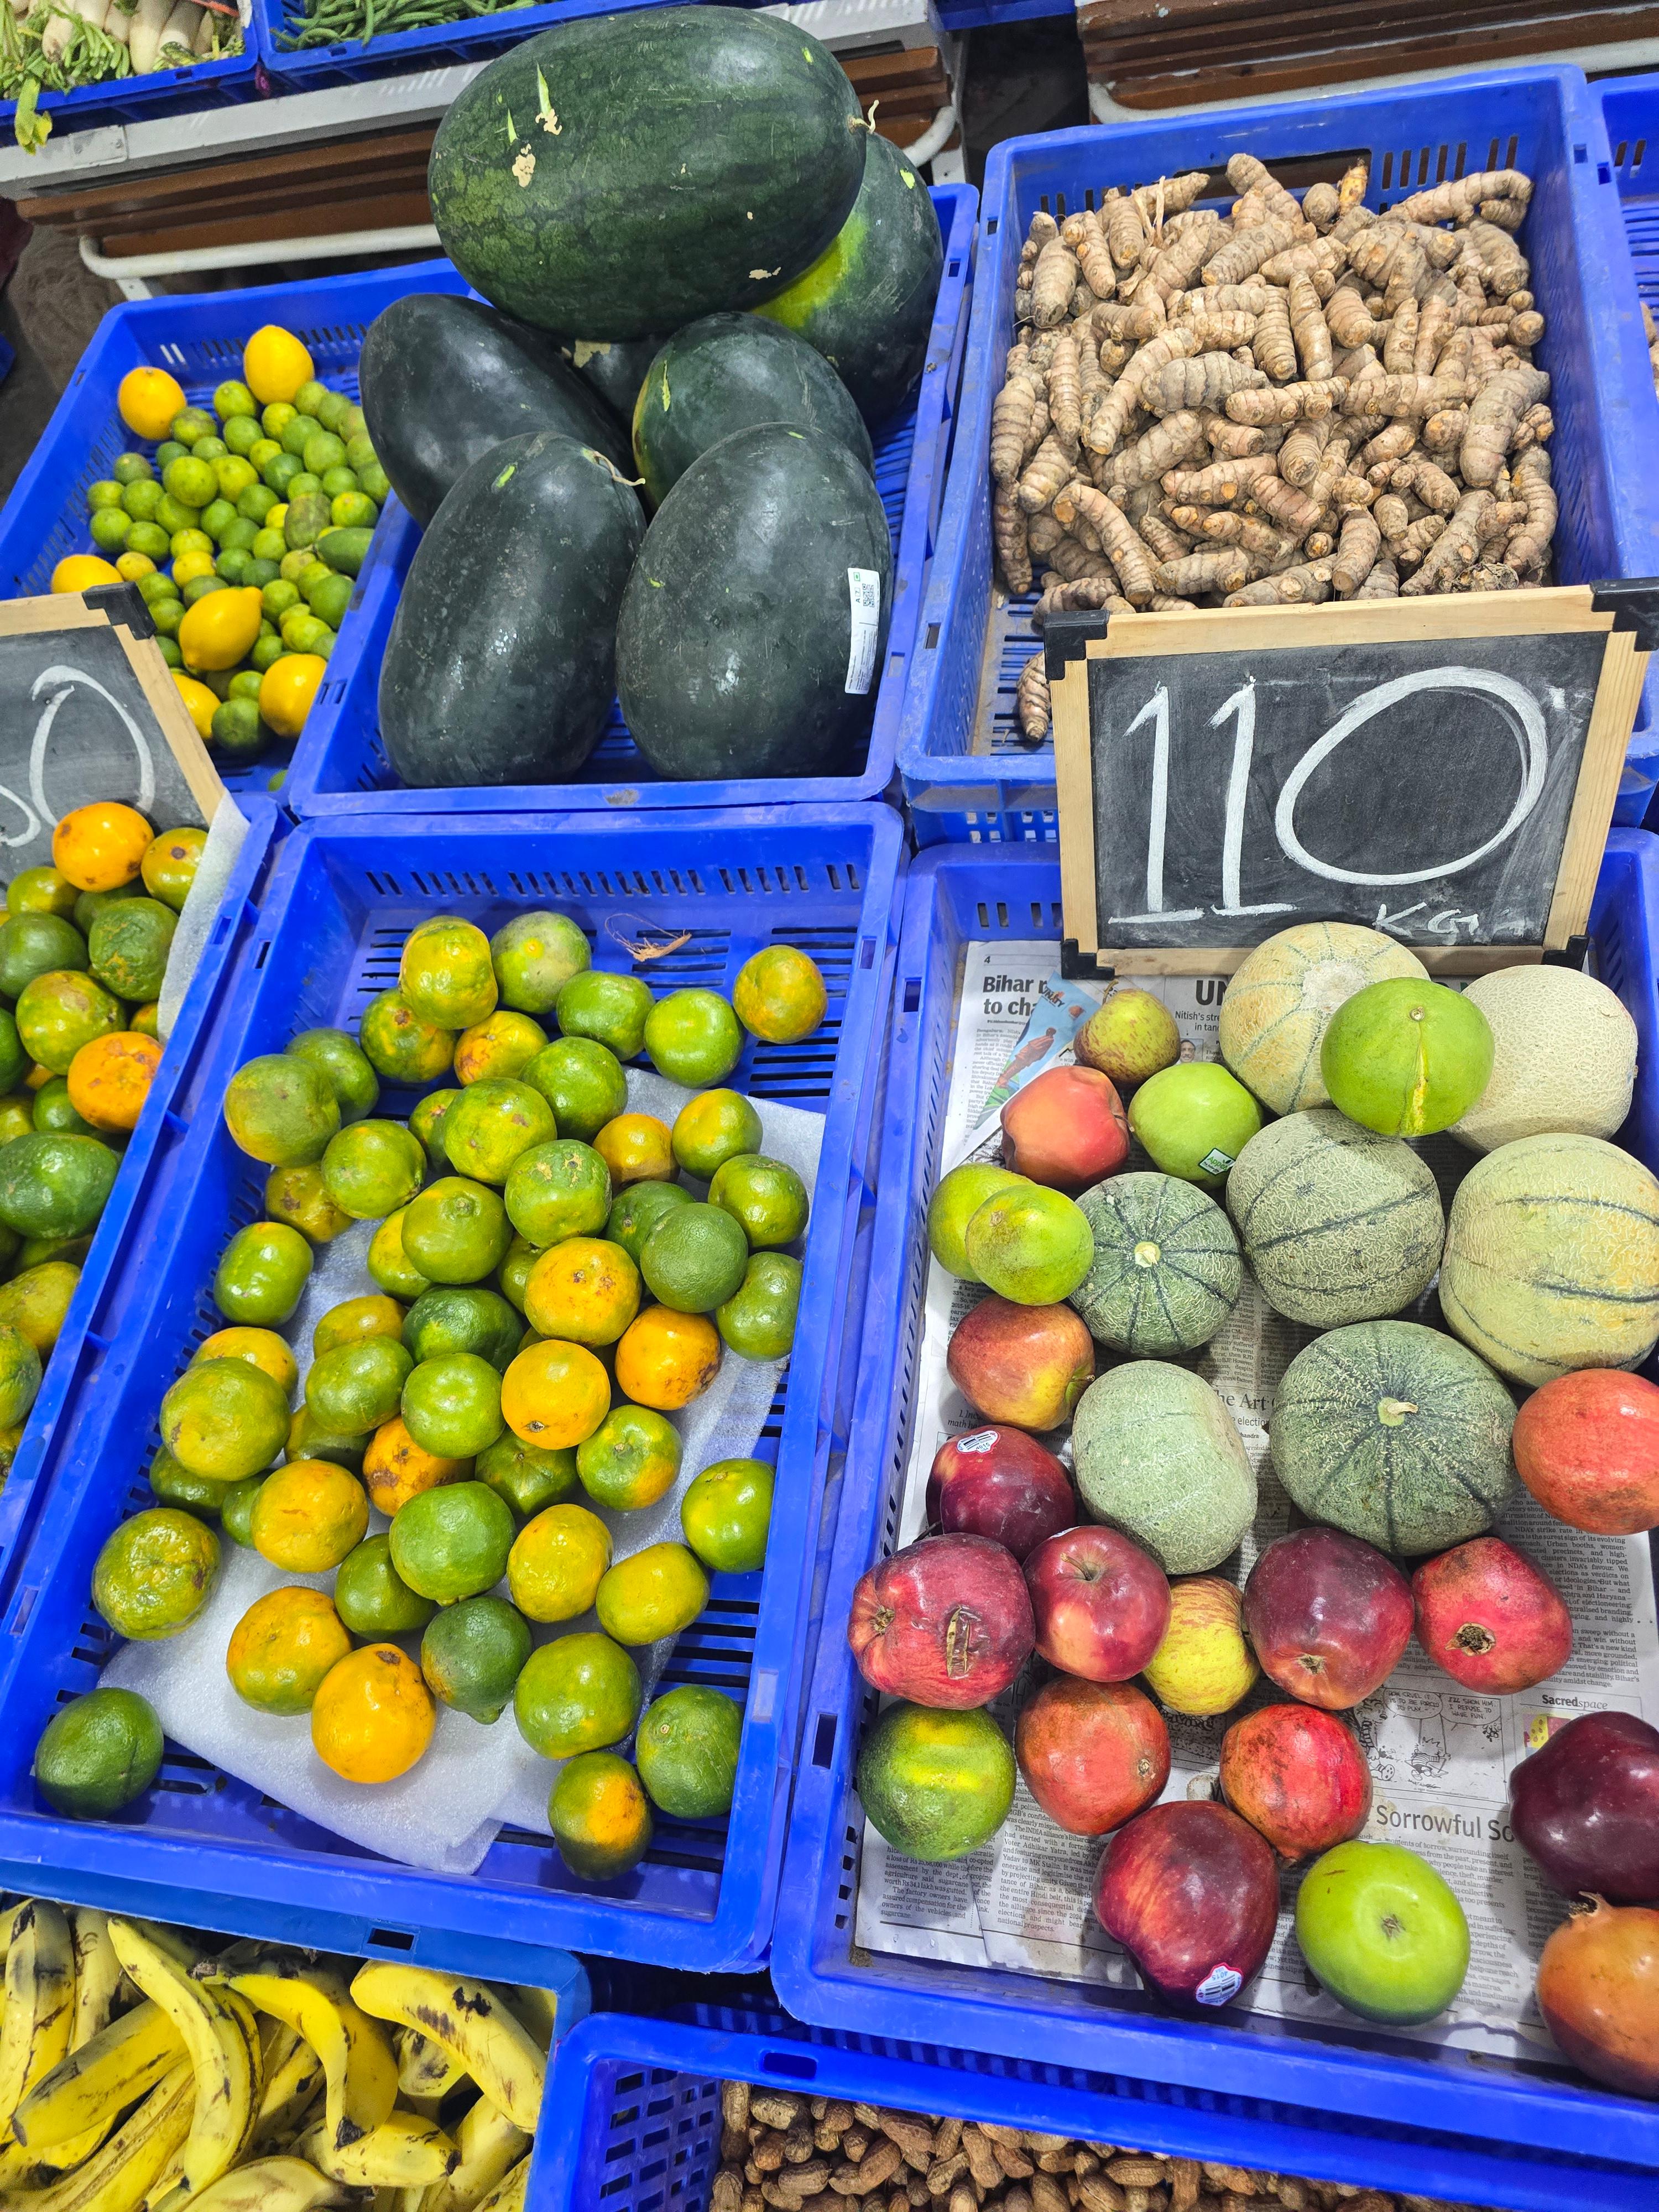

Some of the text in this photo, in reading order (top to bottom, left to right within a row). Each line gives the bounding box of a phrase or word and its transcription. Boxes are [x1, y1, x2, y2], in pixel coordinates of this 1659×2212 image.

[1108, 665, 1548, 924] 110
[984, 956, 991, 964] 4
[983, 974, 1035, 993] Bihar
[984, 999, 1003, 1015] to
[1175, 1011, 1204, 1021] Nitish's
[1195, 1022, 1202, 1031] in
[1239, 1392, 1267, 1410] Art
[947, 1417, 967, 1428] math
[1376, 1804, 1483, 1839] Sorrowful
[1003, 1838, 1020, 1847] Voter
[1022, 1841, 1048, 1851] Adhikar
[1019, 1834, 1041, 1843] started
[1002, 1854, 1020, 1863] Yadav
[1029, 1858, 1041, 1866] MK
[885, 1863, 918, 1872] assessment
[921, 1866, 929, 1875] by
[884, 1870, 918, 1880] agriculture
[938, 1879, 969, 1887] sugarcane
[920, 1882, 934, 1890] lakh
[891, 1885, 904, 1893] The
[906, 1887, 927, 1898] factory
[953, 1894, 968, 1903] have
[1030, 1889, 1048, 1898] Hindi
[1063, 1895, 1076, 1903] this
[905, 1897, 946, 1908] compensation
[1030, 1899, 1074, 1911] consequential
[927, 1908, 952, 1917] vehicles
[997, 1908, 1026, 1918] elections
[1045, 1917, 1065, 1926] might
[997, 1918, 1024, 1927] national
